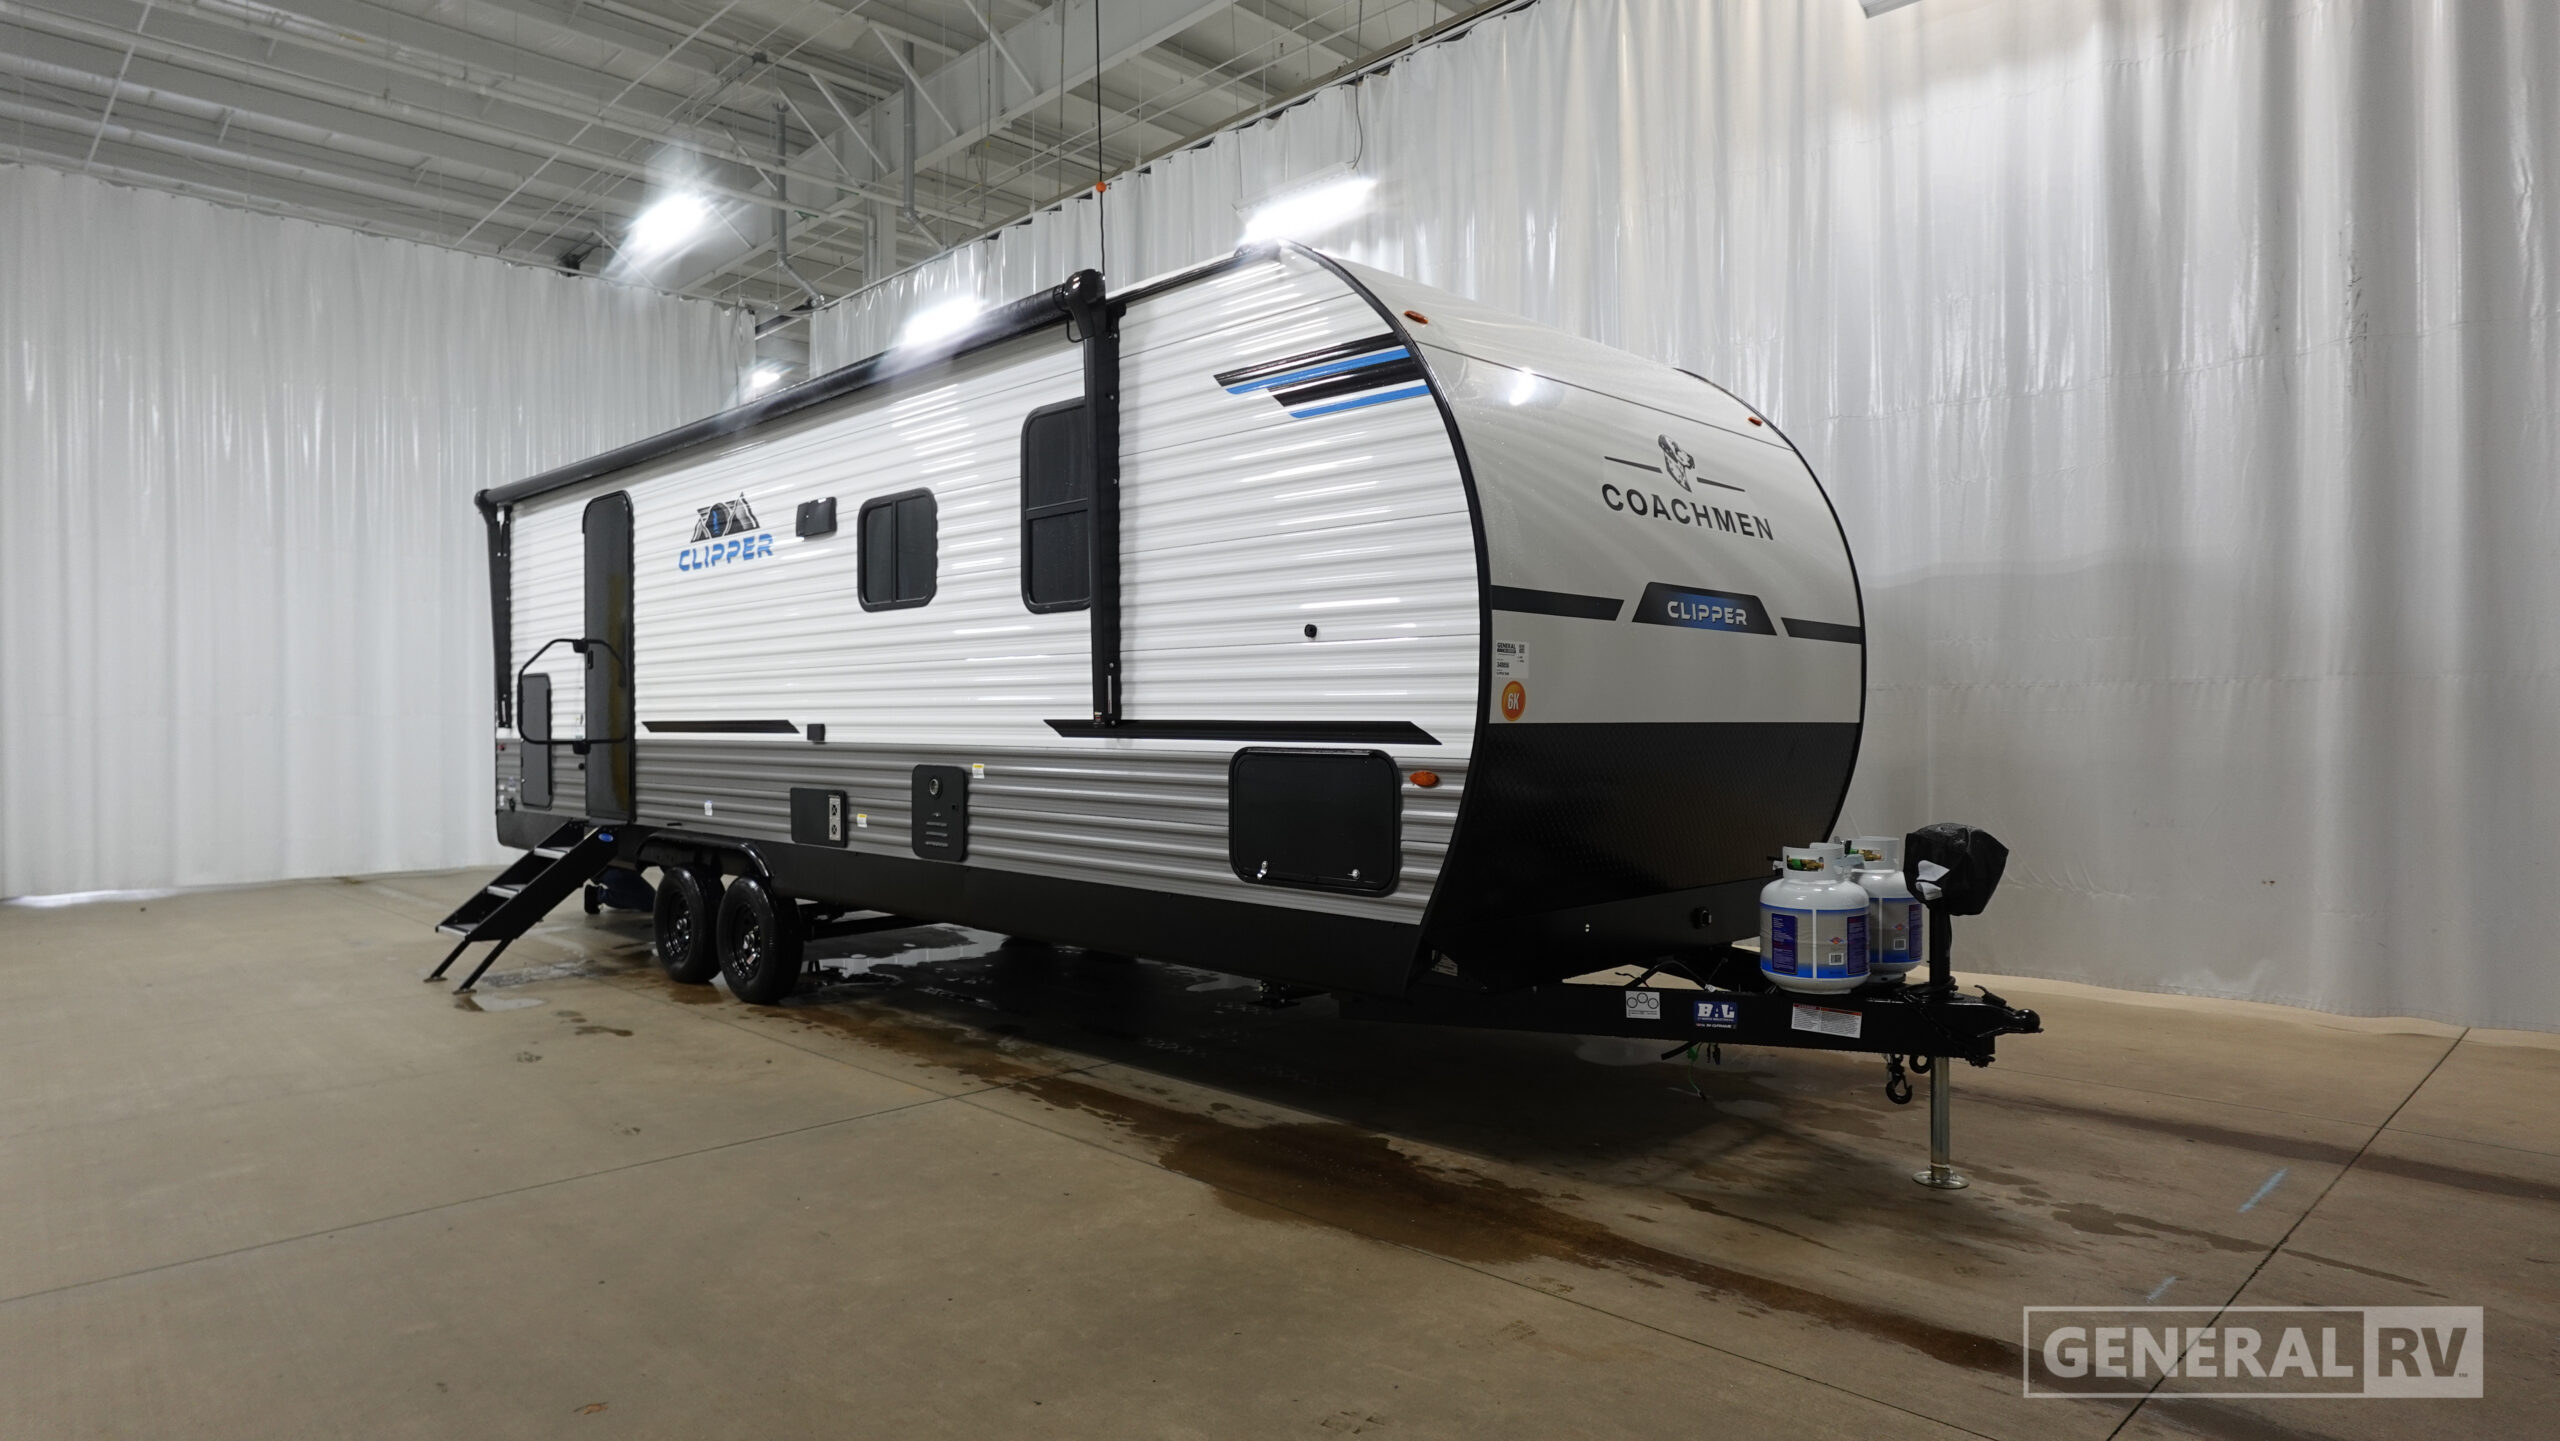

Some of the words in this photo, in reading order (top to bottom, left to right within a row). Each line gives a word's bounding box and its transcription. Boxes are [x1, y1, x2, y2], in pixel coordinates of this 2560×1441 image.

[1601, 483, 1774, 541] COACHMEN
[679, 533, 774, 572] CLIPPER
[1667, 601, 1748, 625] CLIPPER
[1507, 693, 1520, 710] 6K
